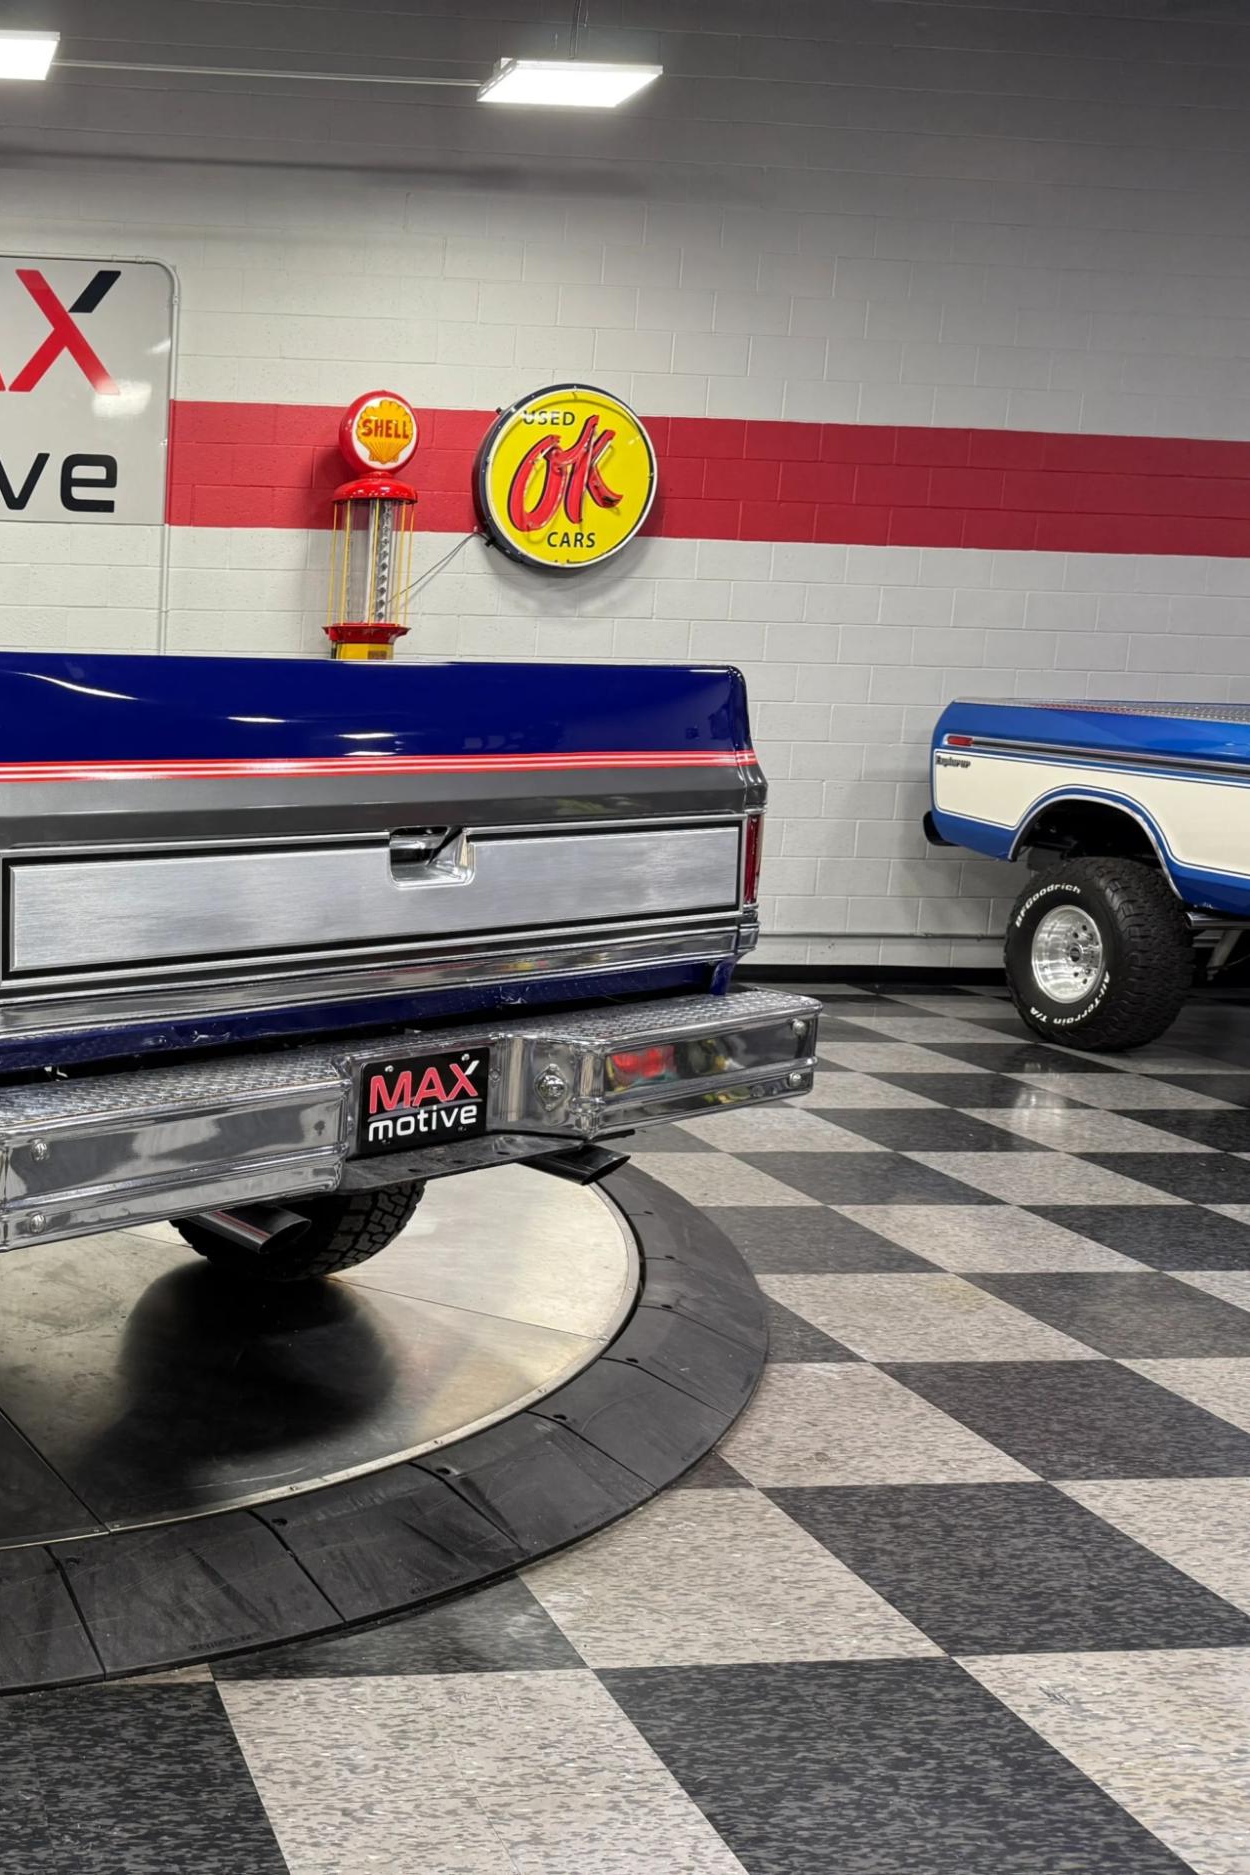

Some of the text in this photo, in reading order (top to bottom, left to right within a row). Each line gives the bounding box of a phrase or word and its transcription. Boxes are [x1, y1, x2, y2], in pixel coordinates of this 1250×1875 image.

[361, 418, 410, 440] SHELL
[523, 410, 575, 426] USED
[507, 414, 624, 532] OK
[547, 531, 596, 548] CARS
[1015, 882, 1081, 928] BFGoodrich
[1029, 970, 1111, 1026] All-Terrain T/A
[369, 1060, 480, 1114] MAX
[368, 1104, 478, 1142] motive
